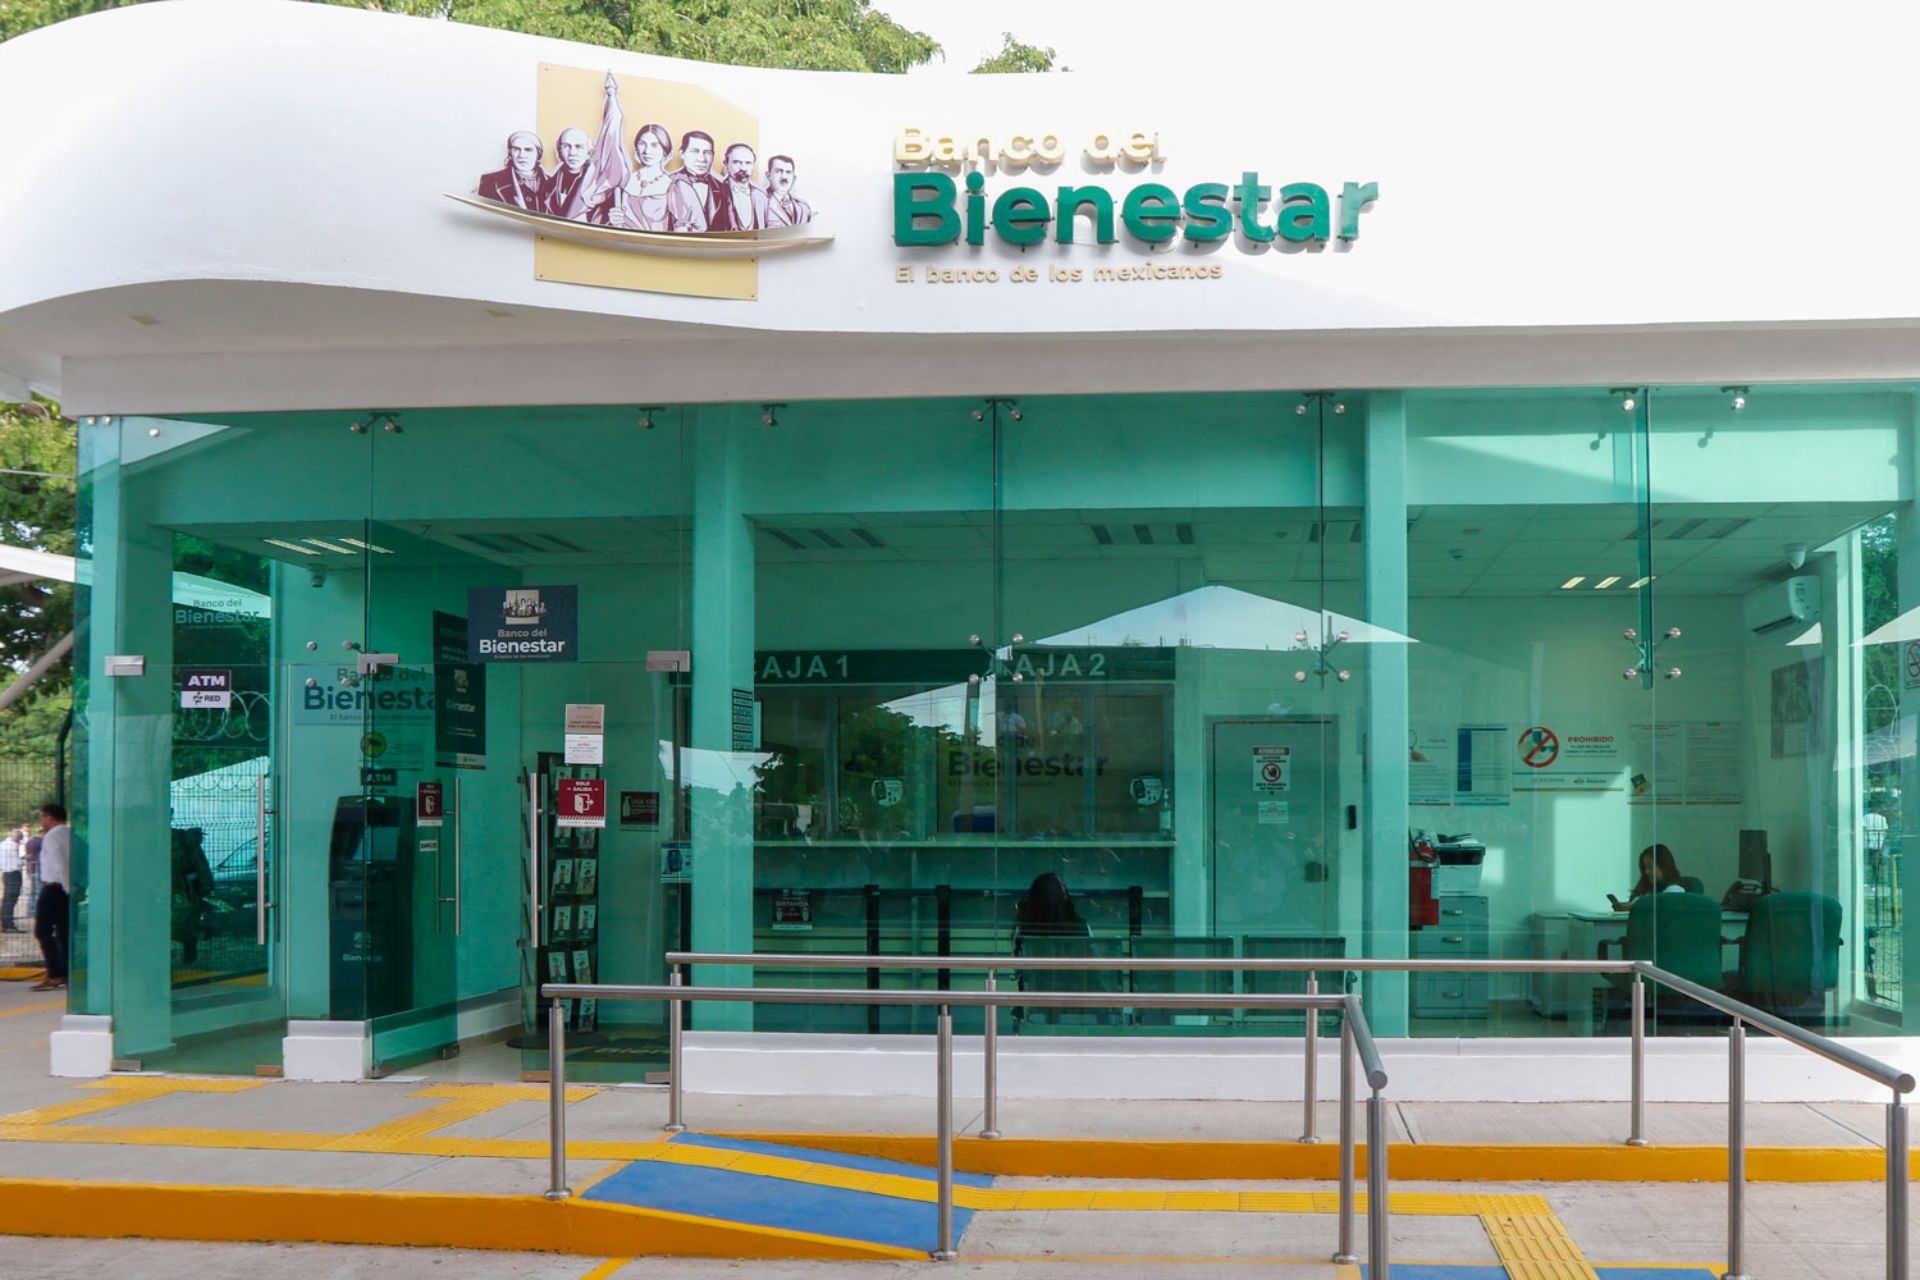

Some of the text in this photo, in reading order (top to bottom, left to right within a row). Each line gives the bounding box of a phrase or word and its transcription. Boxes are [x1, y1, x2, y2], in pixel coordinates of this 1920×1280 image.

[895, 123, 1167, 165] Banco del
[894, 171, 1379, 247] Bienestar
[895, 261, 1222, 283] El banco de los mexicanos
[193, 598, 242, 608] Banco del
[175, 609, 260, 624] Bienestar
[497, 628, 547, 638] Banco del
[479, 639, 566, 654] Bienestar
[754, 654, 848, 679] AJA 1
[1089, 653, 1106, 677] 2
[187, 675, 225, 687] ATM
[336, 667, 394, 681] Bao
